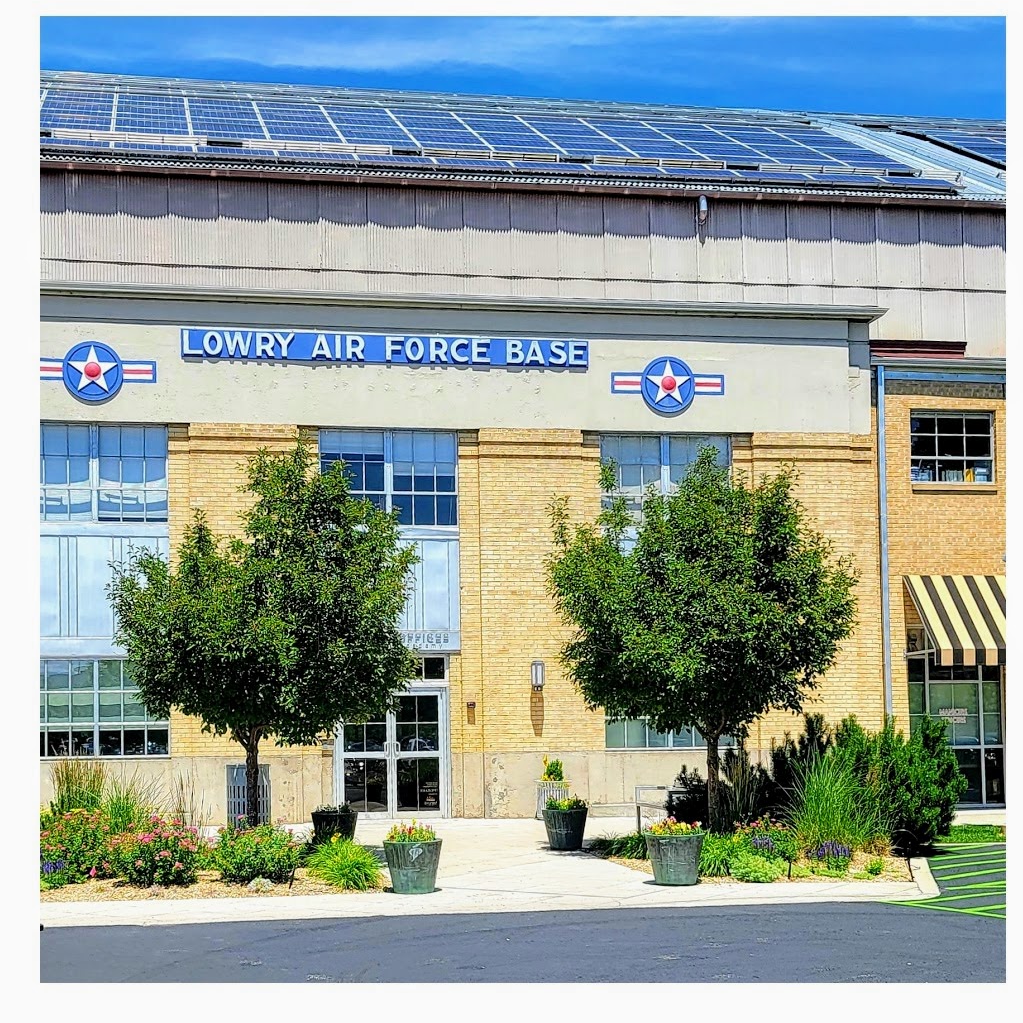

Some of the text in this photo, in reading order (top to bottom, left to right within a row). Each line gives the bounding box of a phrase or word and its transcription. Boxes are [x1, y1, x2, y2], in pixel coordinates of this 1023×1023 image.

[182, 328, 589, 366] LOWRY AIR FORCE BASE
